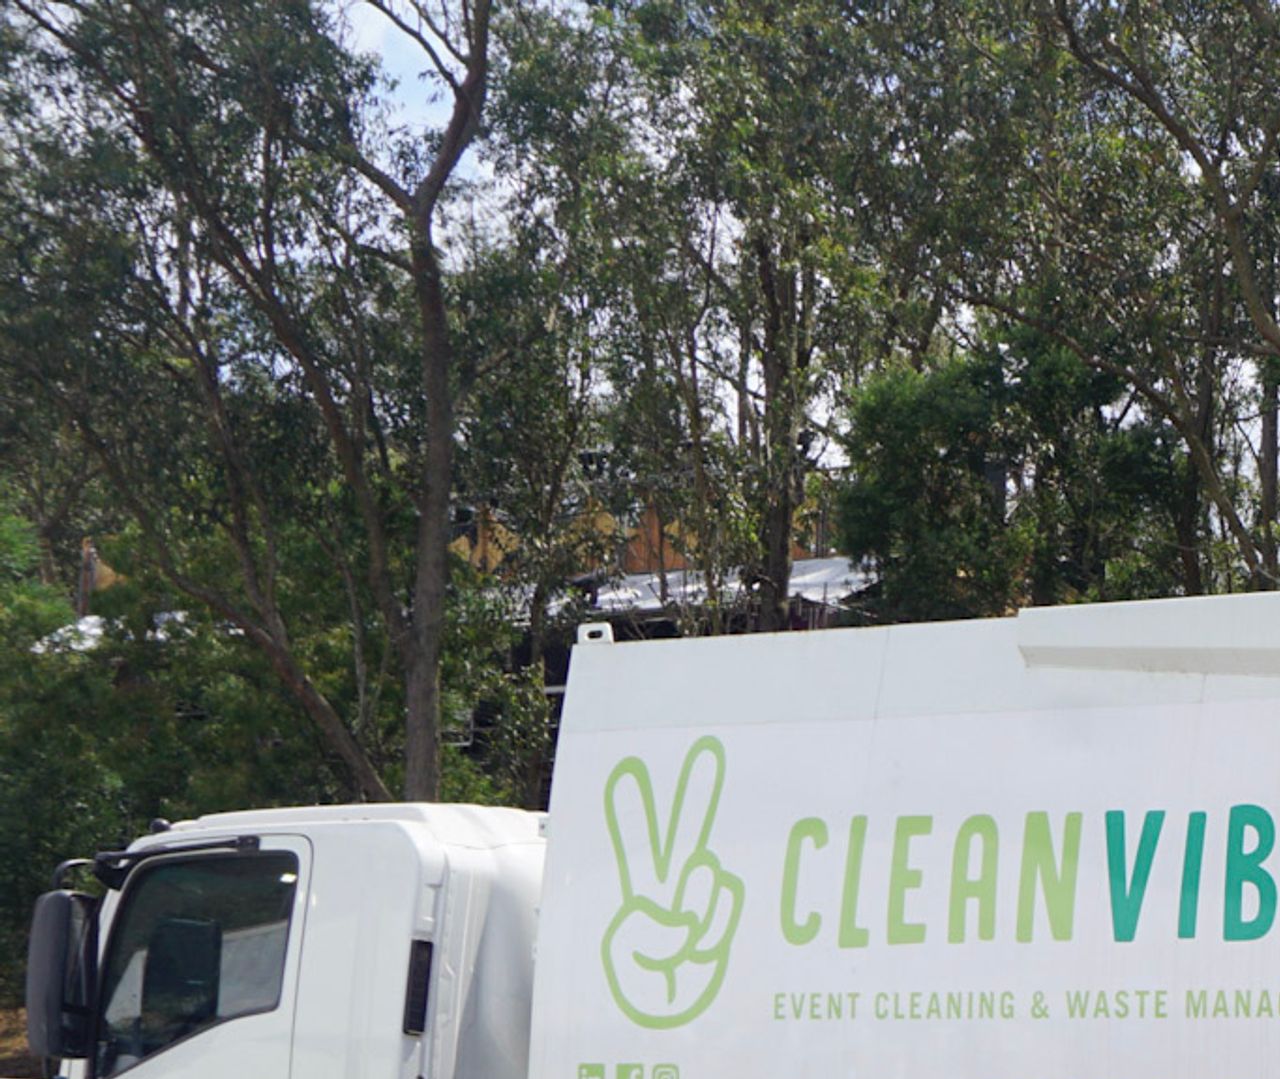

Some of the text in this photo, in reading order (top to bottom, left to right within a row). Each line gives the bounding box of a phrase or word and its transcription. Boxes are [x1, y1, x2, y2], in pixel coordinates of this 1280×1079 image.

[773, 992, 861, 1021] EVENT
[874, 991, 1015, 1020] CLEANING
[1031, 990, 1050, 1019] &
[1066, 990, 1168, 1020] WASTE
